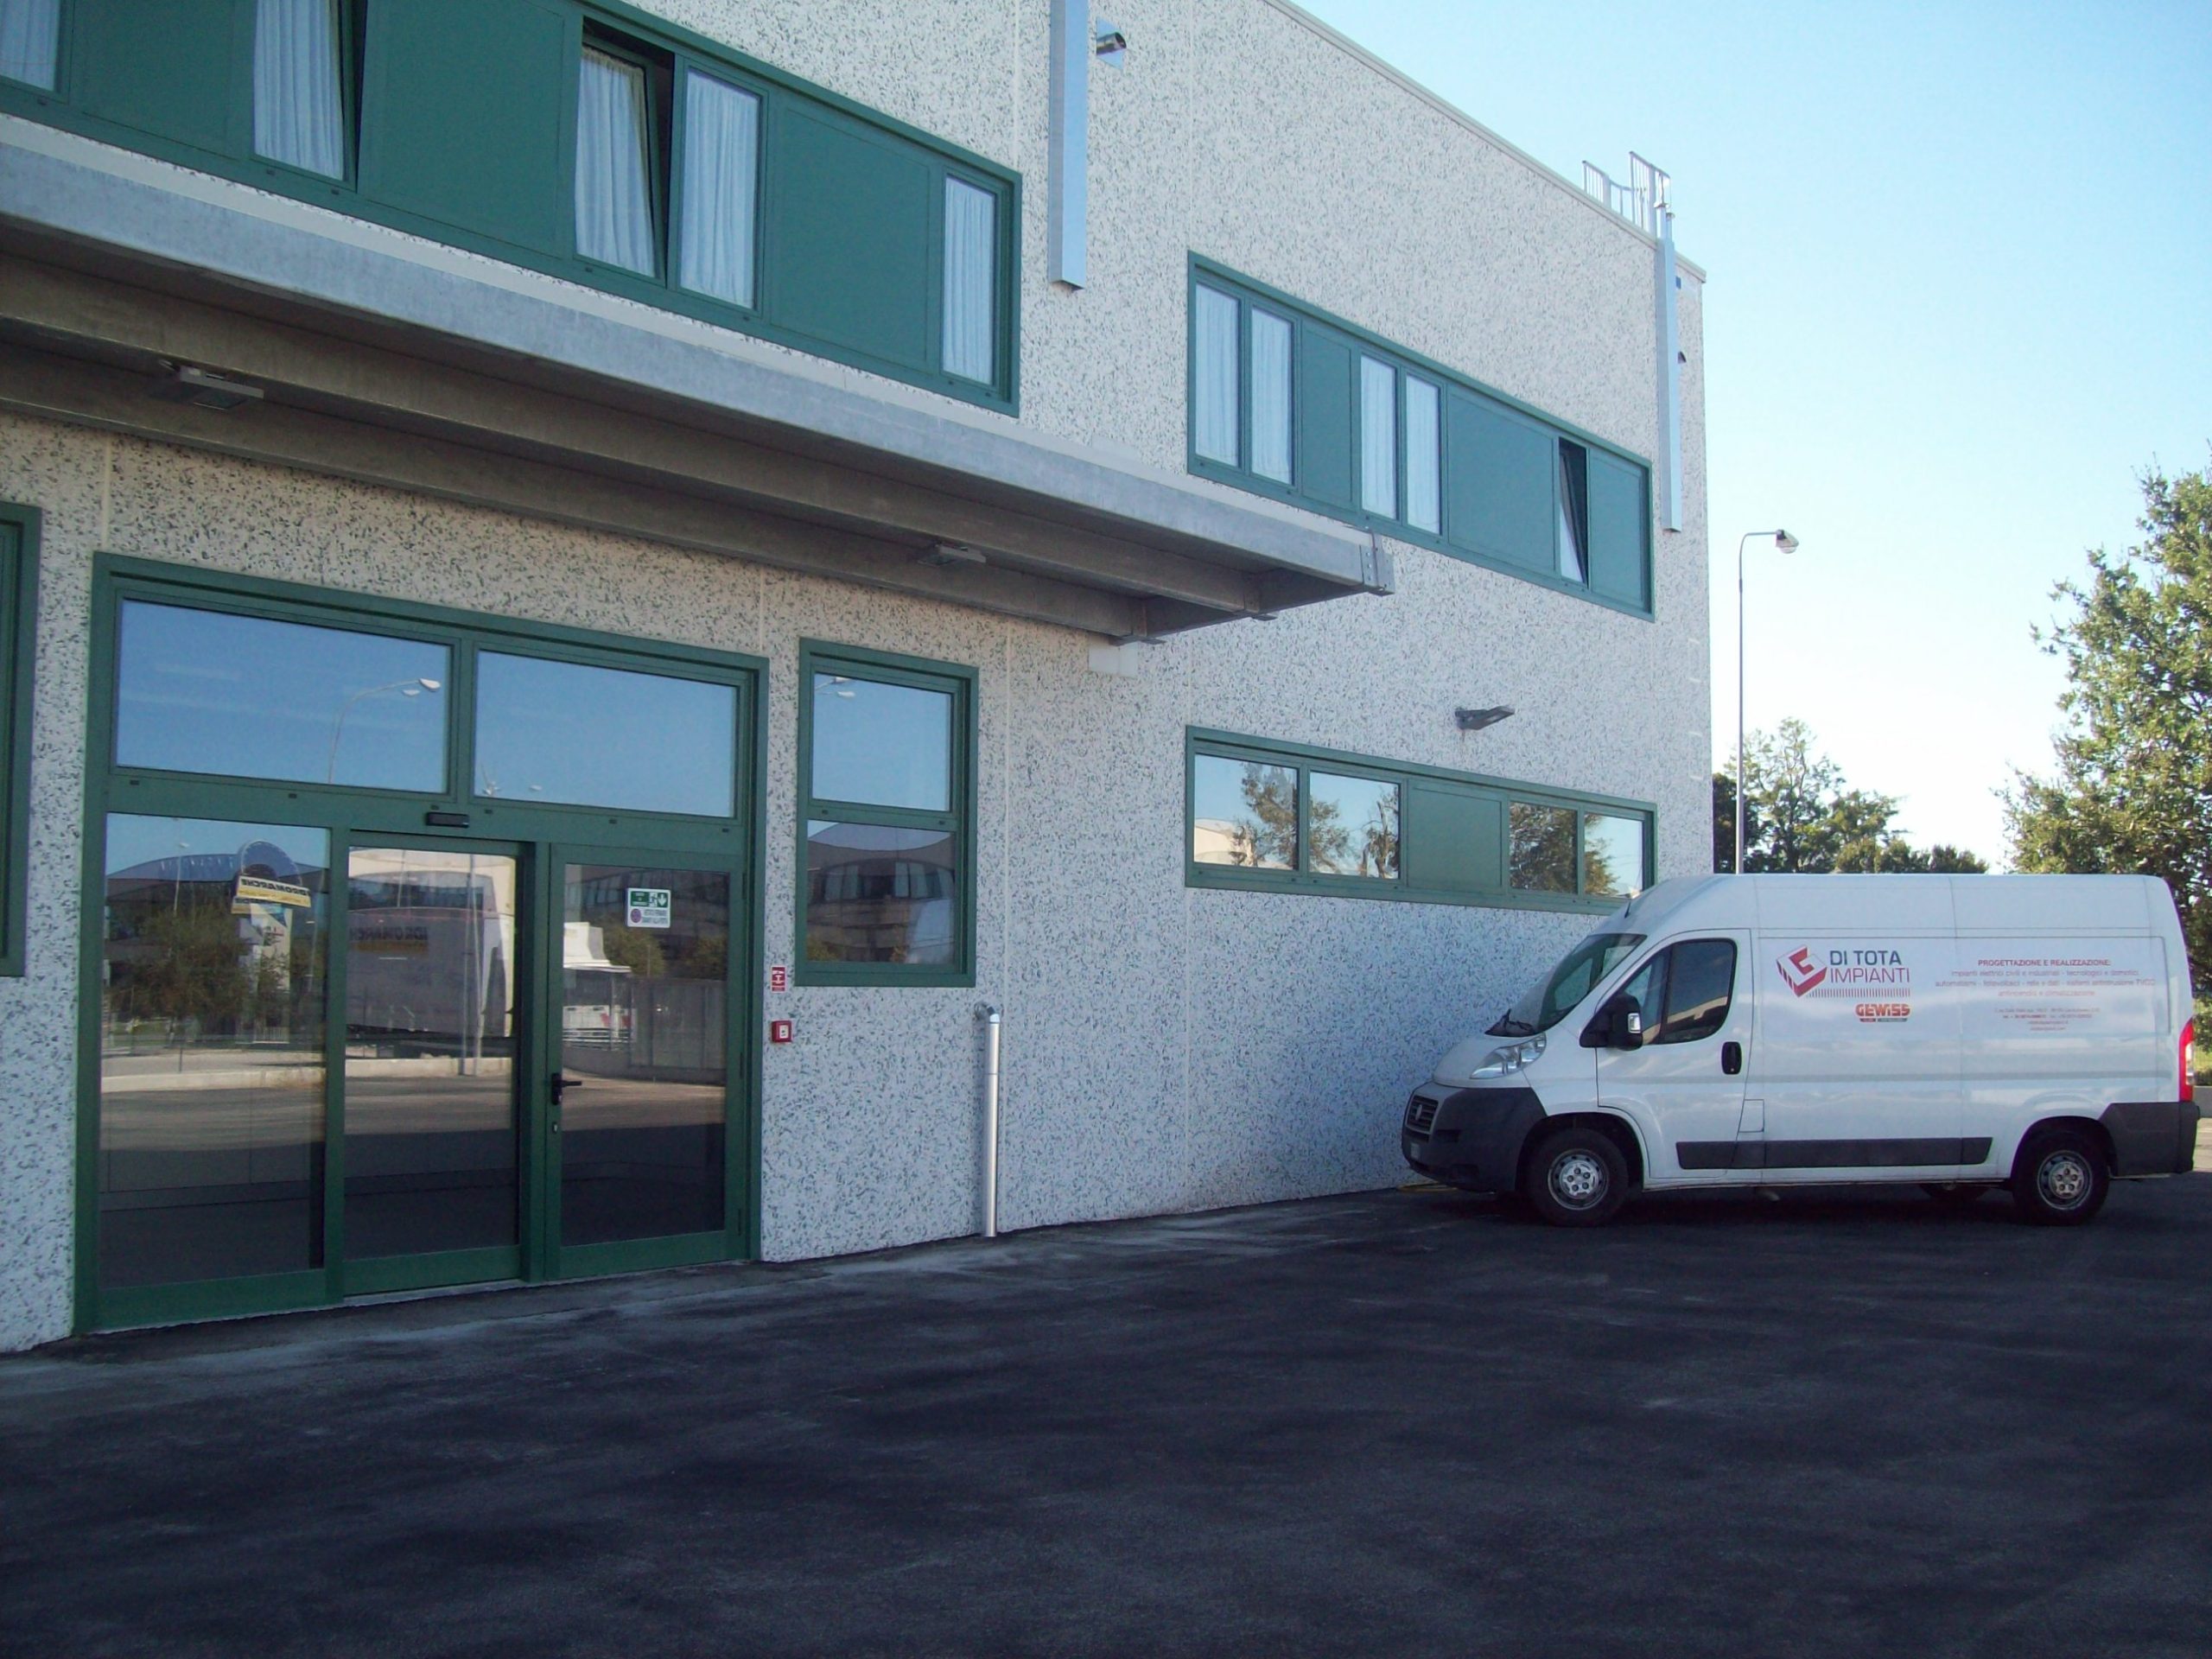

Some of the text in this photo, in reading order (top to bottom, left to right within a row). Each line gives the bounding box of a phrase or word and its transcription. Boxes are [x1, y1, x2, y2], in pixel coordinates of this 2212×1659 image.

[1830, 950, 1903, 966] DI TOTA
[1830, 968, 1910, 984] IMPIANTI
